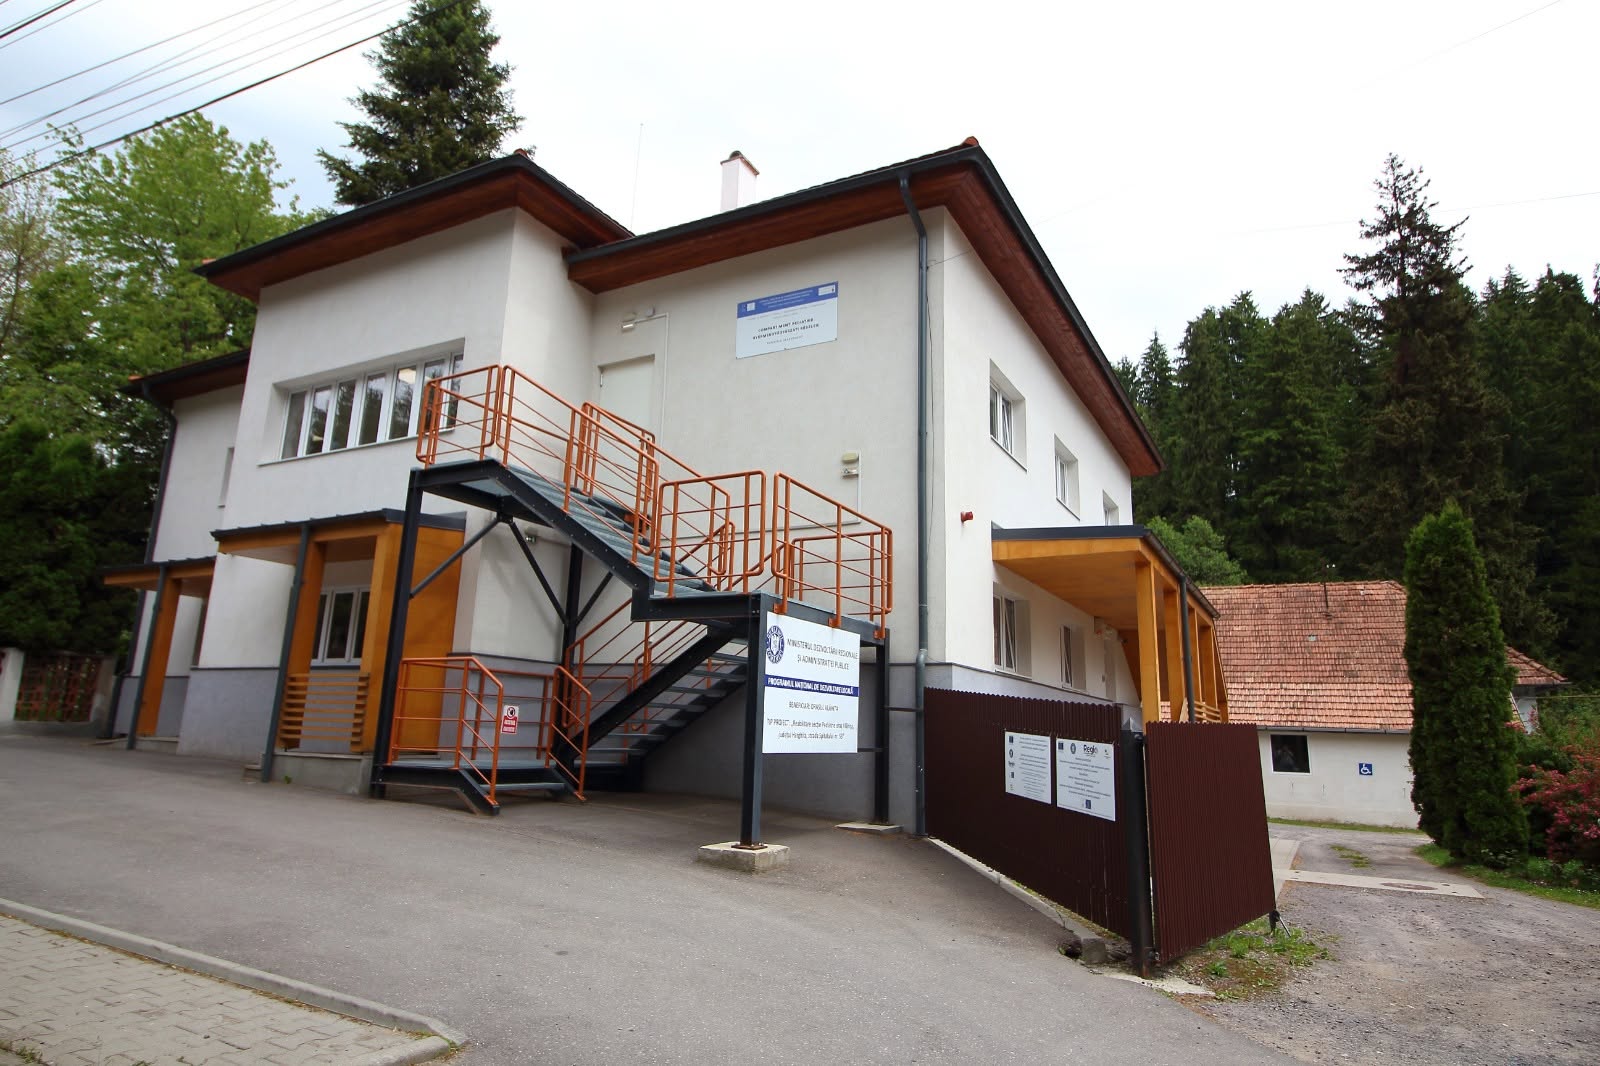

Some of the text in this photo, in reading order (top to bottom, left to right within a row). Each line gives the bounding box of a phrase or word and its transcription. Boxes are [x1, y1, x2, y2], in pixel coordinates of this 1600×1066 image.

[787, 639, 813, 651] MINISTERUL
[838, 648, 858, 660] REGIONALE
[767, 677, 794, 688] PROGRAMUL
[814, 683, 820, 691] DE
